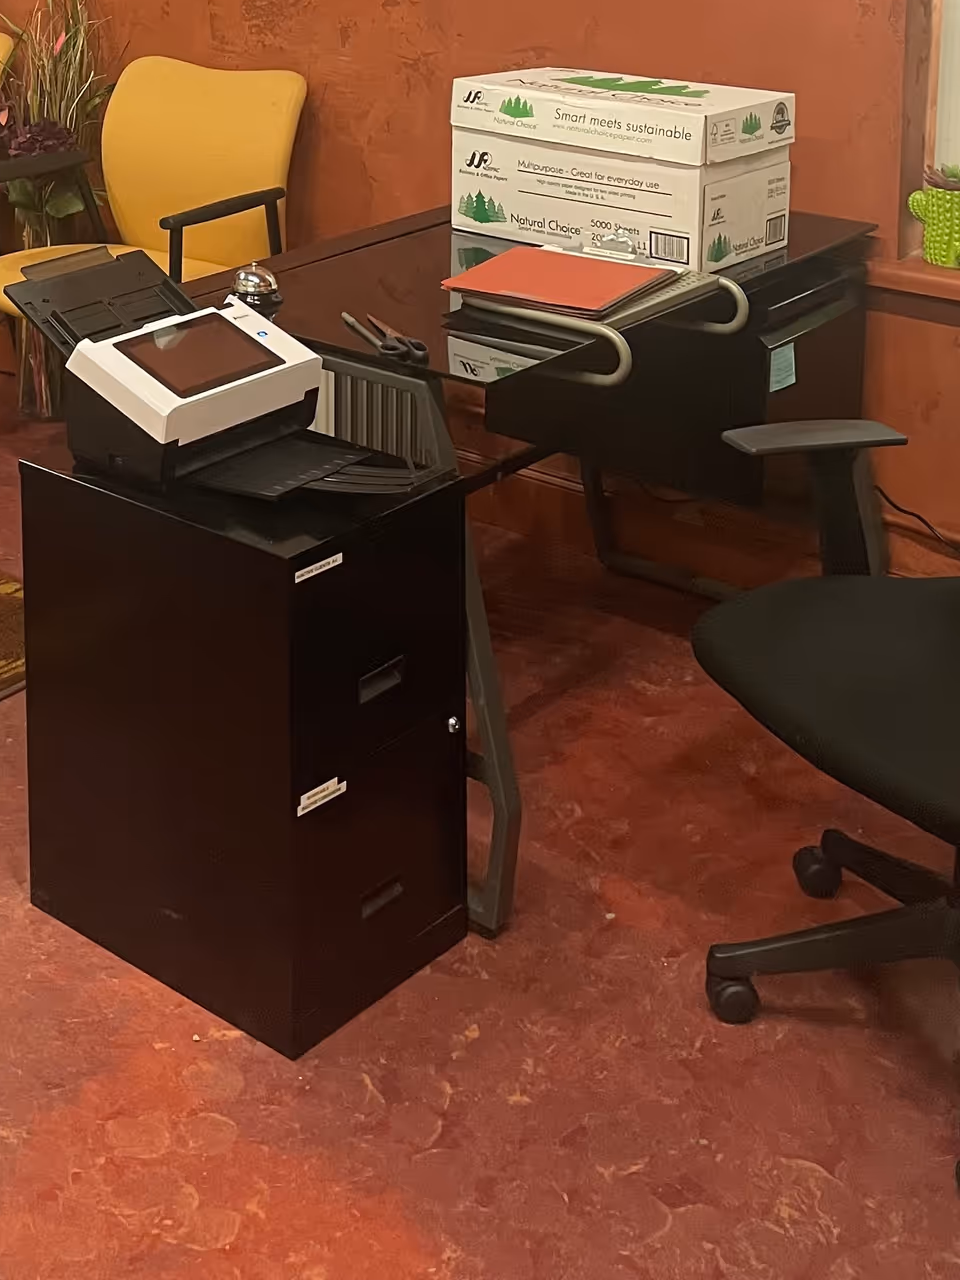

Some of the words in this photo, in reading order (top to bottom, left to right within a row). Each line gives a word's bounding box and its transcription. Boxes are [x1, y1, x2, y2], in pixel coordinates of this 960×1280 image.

[493, 116, 515, 126] Natural
[554, 107, 587, 124] Smart
[590, 116, 622, 130] meets
[626, 122, 692, 141] sustainable
[517, 160, 564, 175] Multipurpose
[570, 167, 593, 179] Great
[594, 172, 605, 180] for
[607, 176, 644, 189] everyday
[645, 181, 660, 189] use
[510, 213, 546, 228] Natural
[548, 220, 581, 235] Choice
[590, 219, 612, 230] 5000
